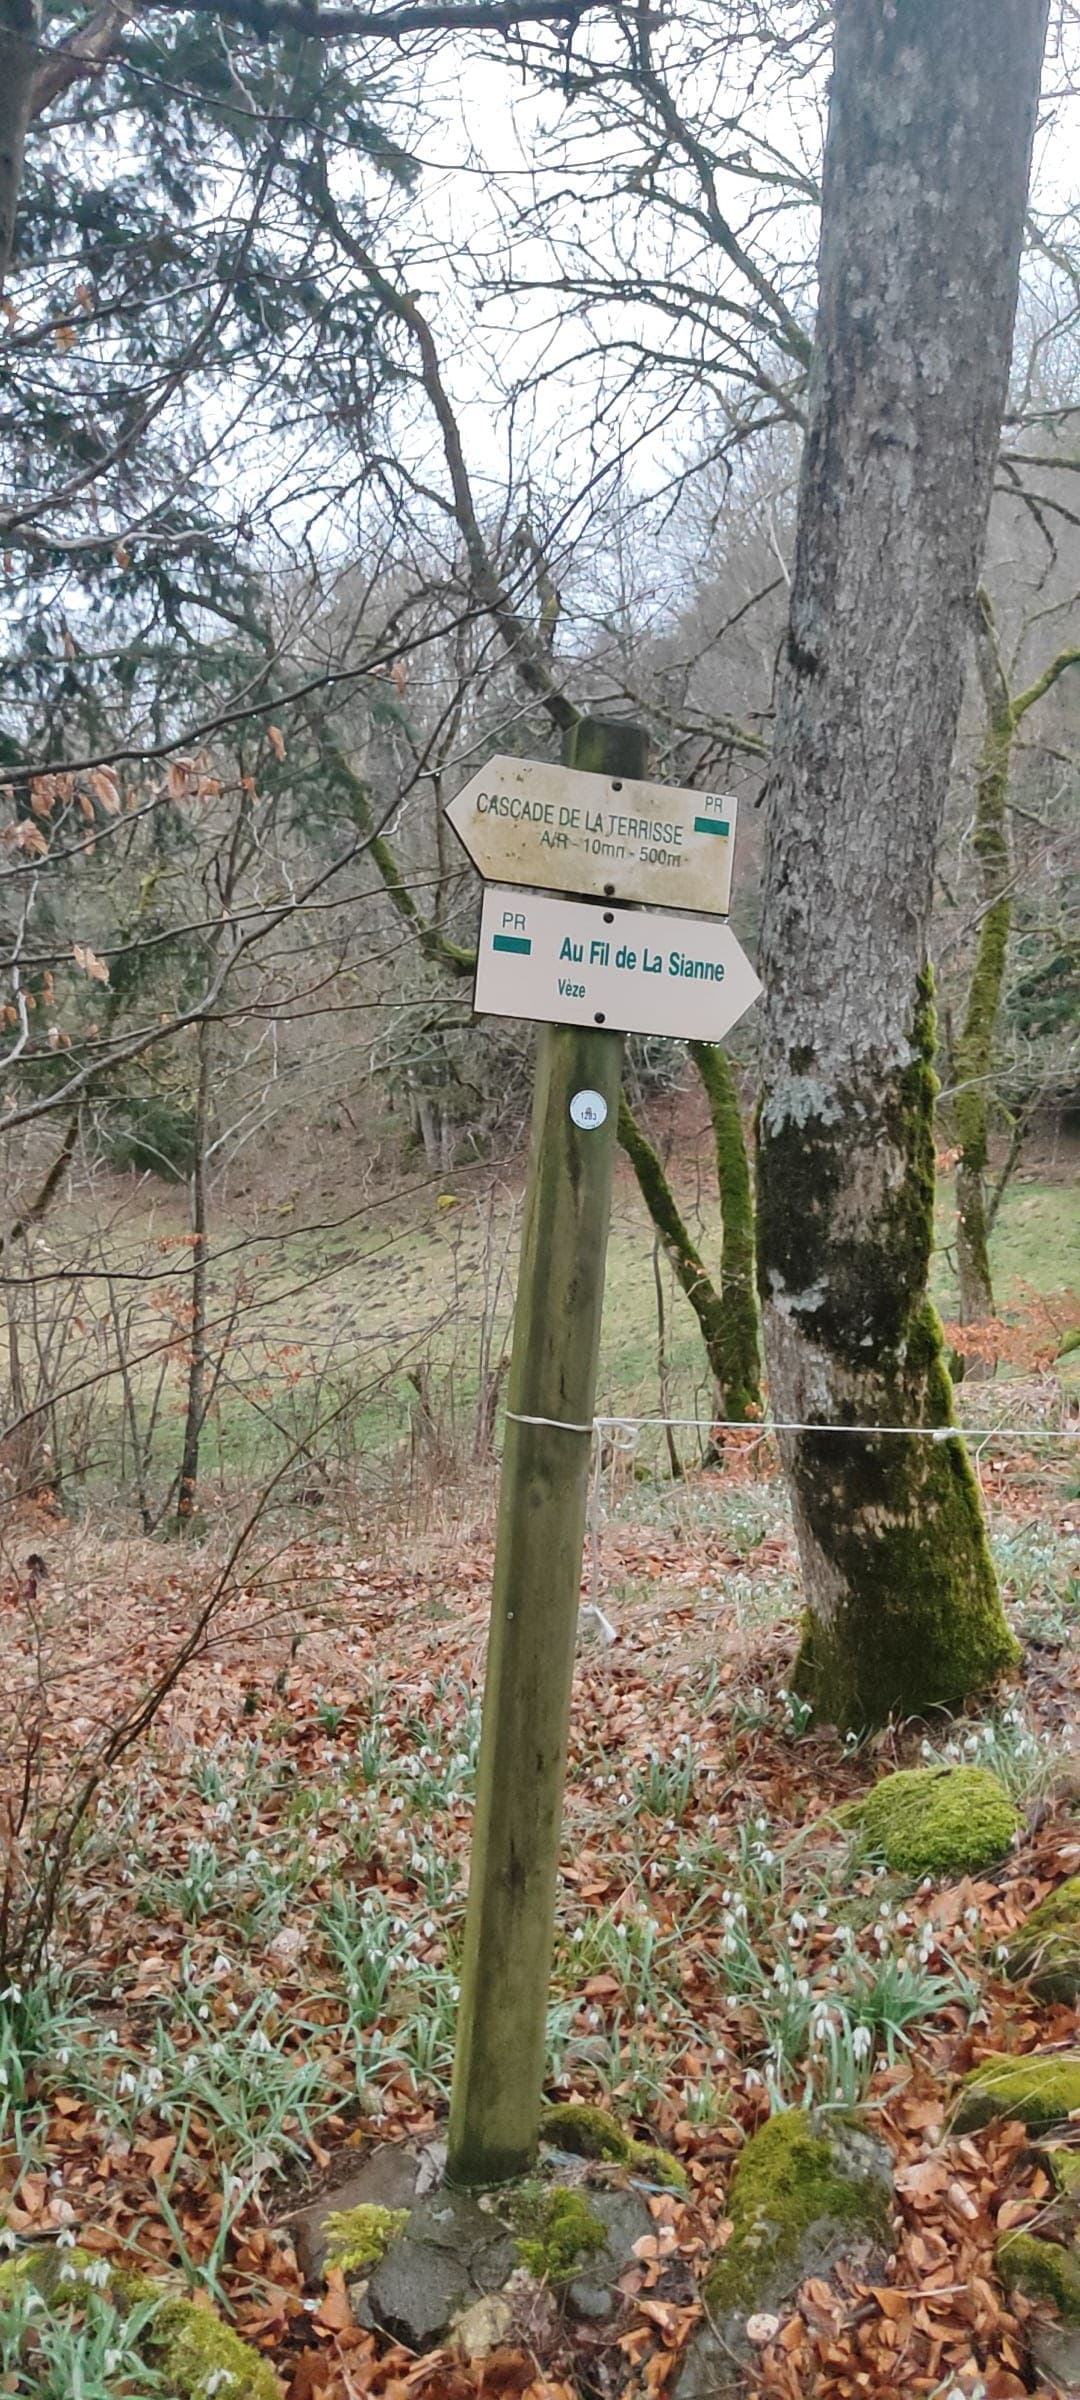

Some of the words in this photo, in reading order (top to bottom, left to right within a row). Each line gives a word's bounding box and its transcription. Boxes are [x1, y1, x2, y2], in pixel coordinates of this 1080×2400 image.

[705, 796, 723, 813] PR
[476, 792, 554, 824] CASCADE
[559, 808, 581, 827] DE
[586, 811, 603, 832] LA
[608, 815, 684, 846] TERRISSE
[540, 831, 568, 850] A/R
[584, 838, 625, 859] 10mn
[640, 847, 681, 867] 500m
[502, 912, 526, 931] PR
[559, 937, 583, 962] Au
[590, 940, 609, 966] Fil
[616, 945, 636, 970] de
[643, 948, 662, 974] La
[668, 952, 725, 982] Sianne
[558, 978, 586, 998] Vèze
